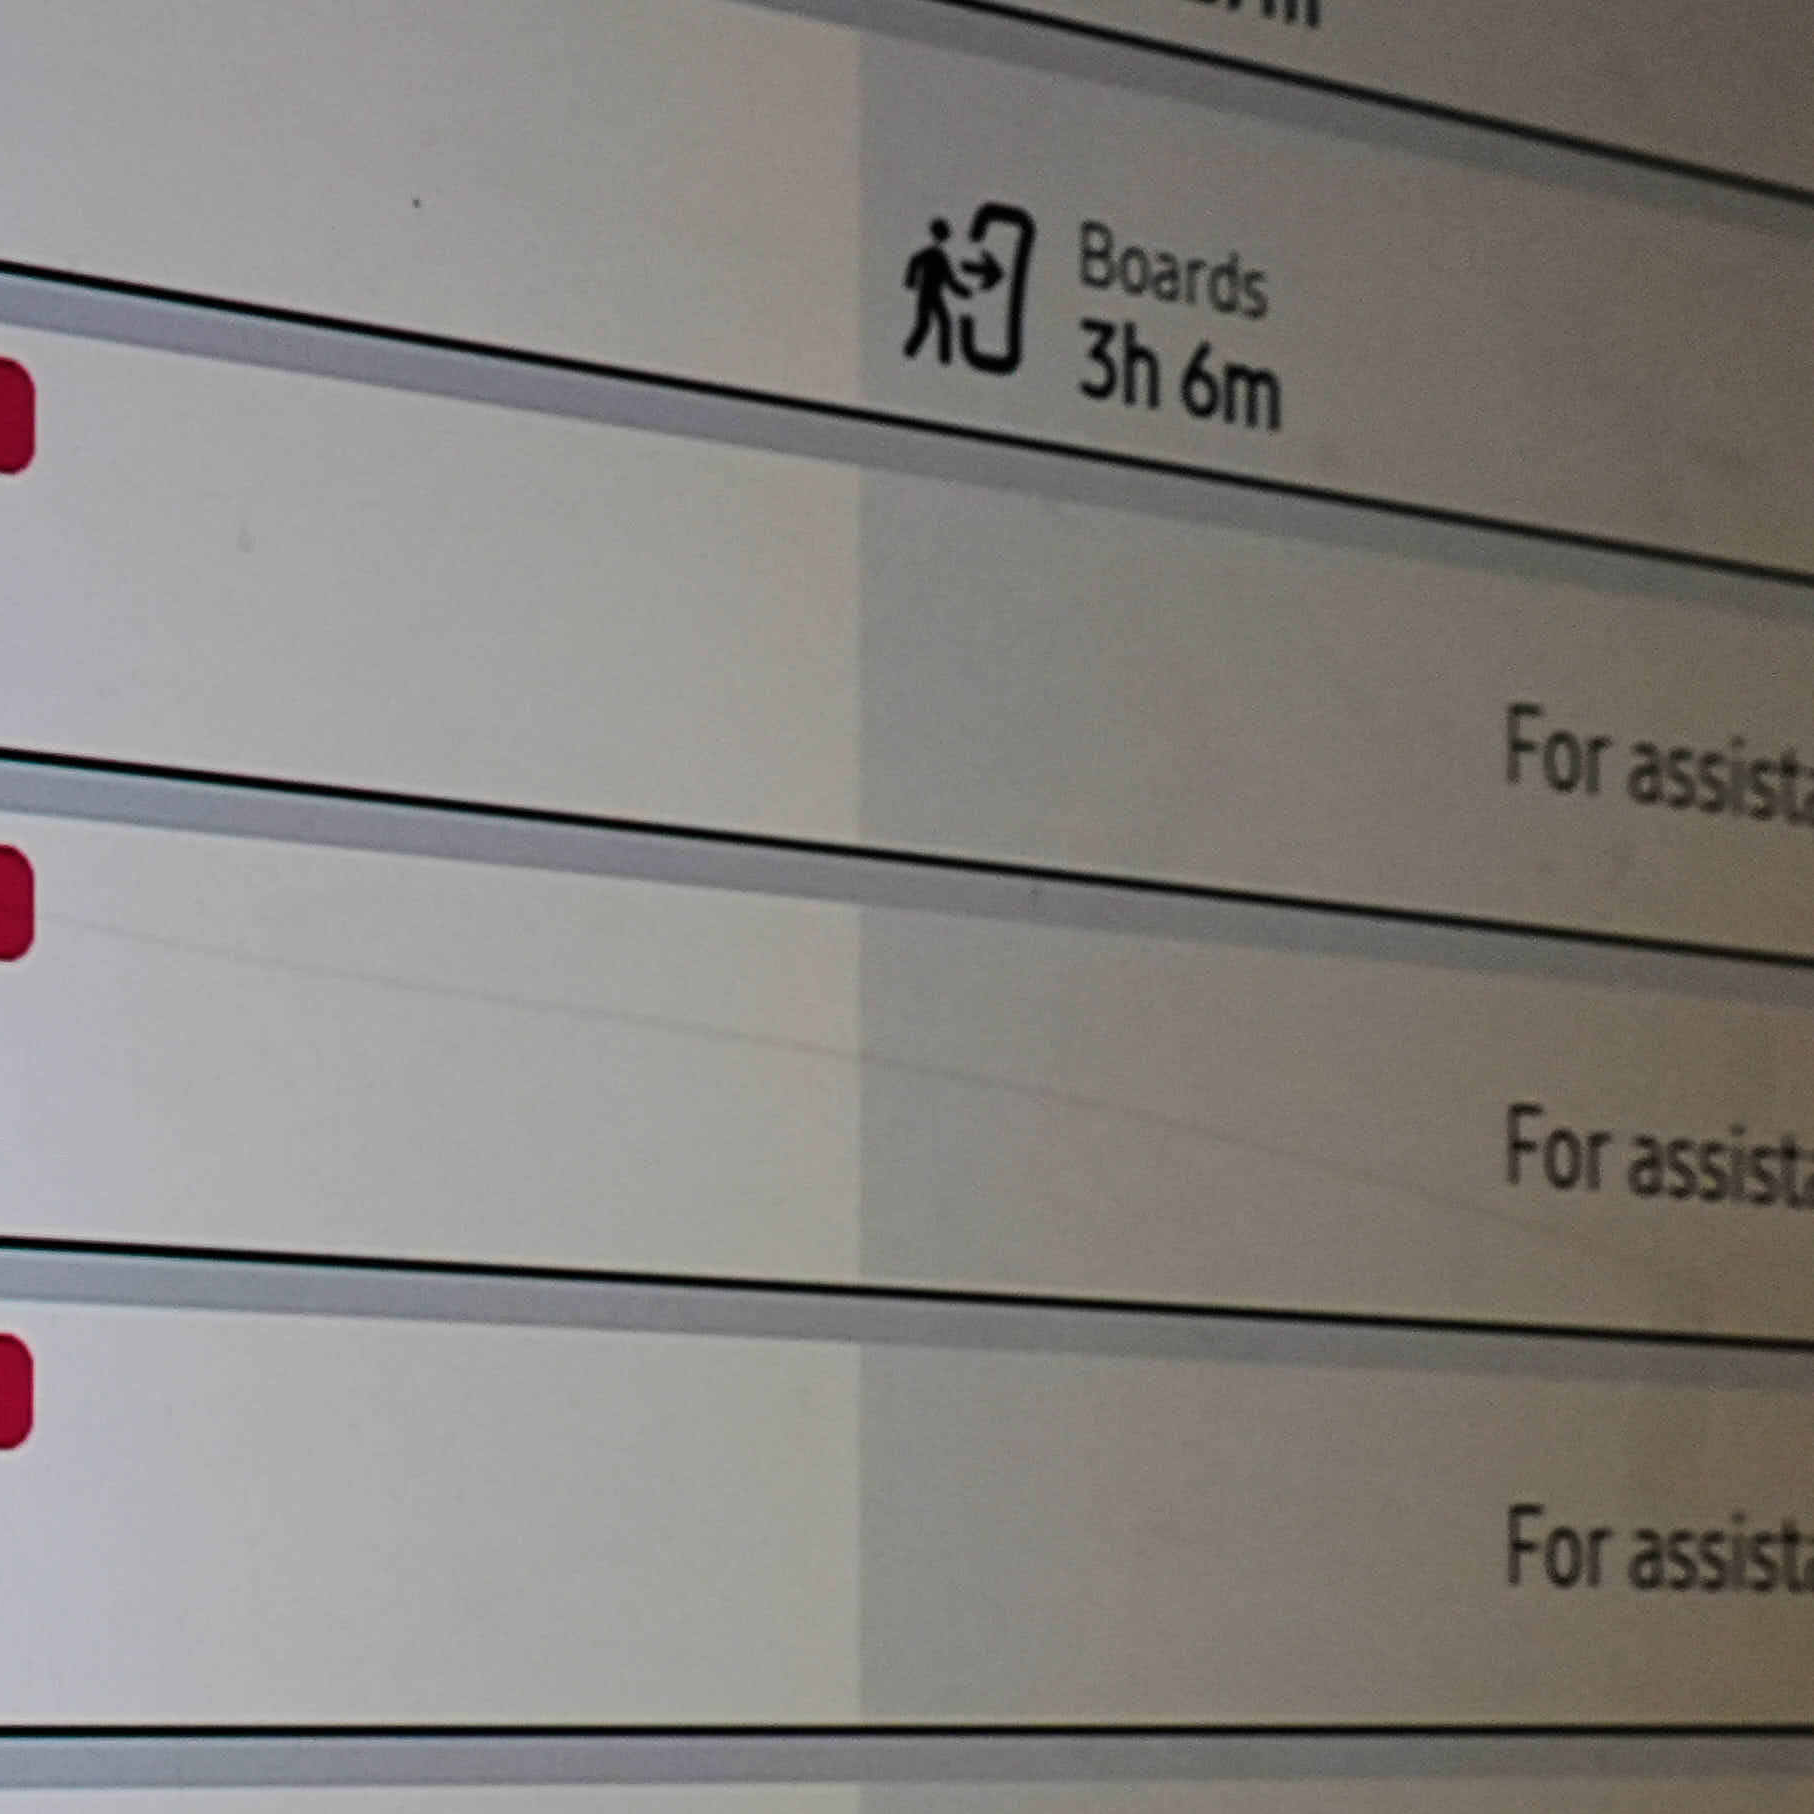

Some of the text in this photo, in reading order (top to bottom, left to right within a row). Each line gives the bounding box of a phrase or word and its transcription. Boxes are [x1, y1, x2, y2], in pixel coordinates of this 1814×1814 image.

[1080, 220, 1268, 320] Boards
[1080, 318, 1281, 430] 3h 6m
[1508, 703, 1814, 828] For assist
[1507, 1103, 1814, 1209] For assist
[1508, 1503, 1814, 1594] For assist
